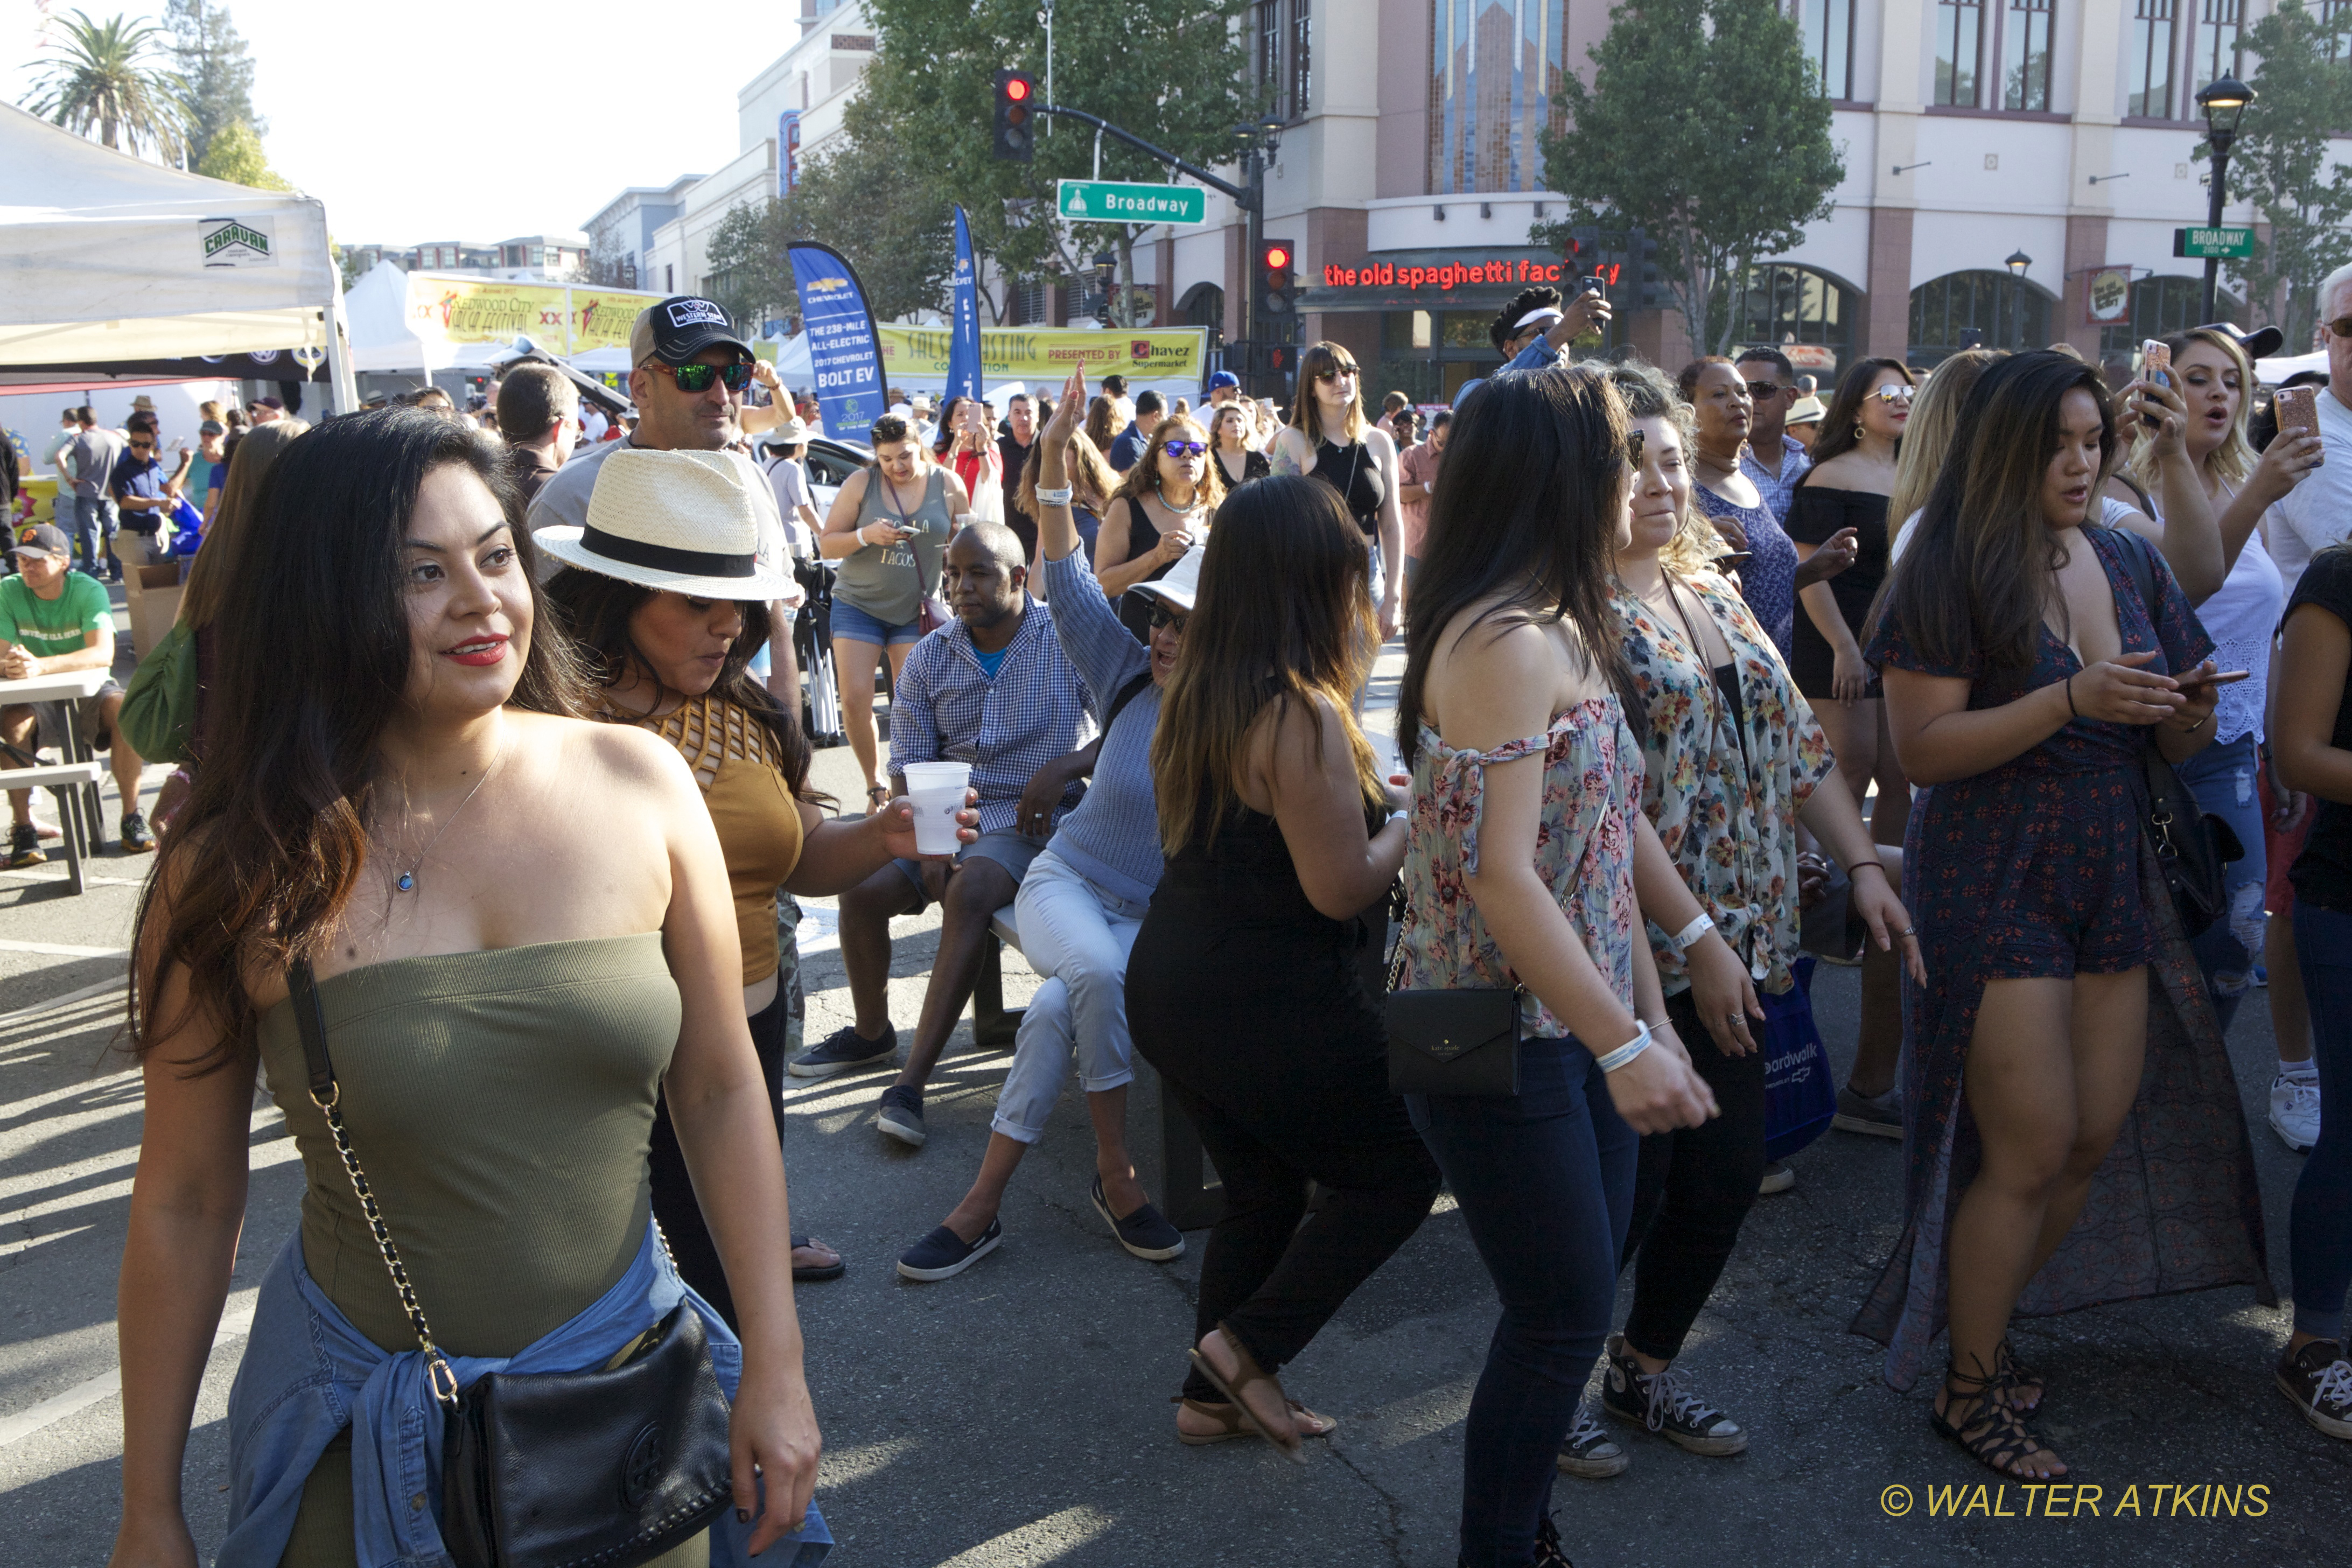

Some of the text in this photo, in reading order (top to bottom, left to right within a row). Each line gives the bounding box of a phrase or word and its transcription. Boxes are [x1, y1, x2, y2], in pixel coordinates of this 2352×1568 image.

[1106, 194, 1188, 216] Broadway
[205, 226, 269, 254] CARAVAN
[2192, 230, 2245, 246] BROADWAY
[1325, 260, 1620, 290] the old spaghetti facry
[808, 291, 853, 304] CHEVROLET
[676, 312, 723, 321] WESTERN STAR
[810, 320, 866, 337] THE 238-MILE
[811, 334, 870, 352] ALL-ELECTRIC
[982, 333, 1036, 362] ASTING
[1048, 349, 1104, 360] PRESENTED
[1108, 349, 1121, 360] BY
[1133, 343, 1190, 357] Chavez
[814, 351, 873, 368] 2017 CHEVROLET
[1132, 359, 1187, 369] Supermarket
[818, 366, 874, 388] BOLT EV
[841, 411, 865, 423] 2017
[880, 548, 916, 568] TACOS
[1764, 1042, 1818, 1075] oardwalk
